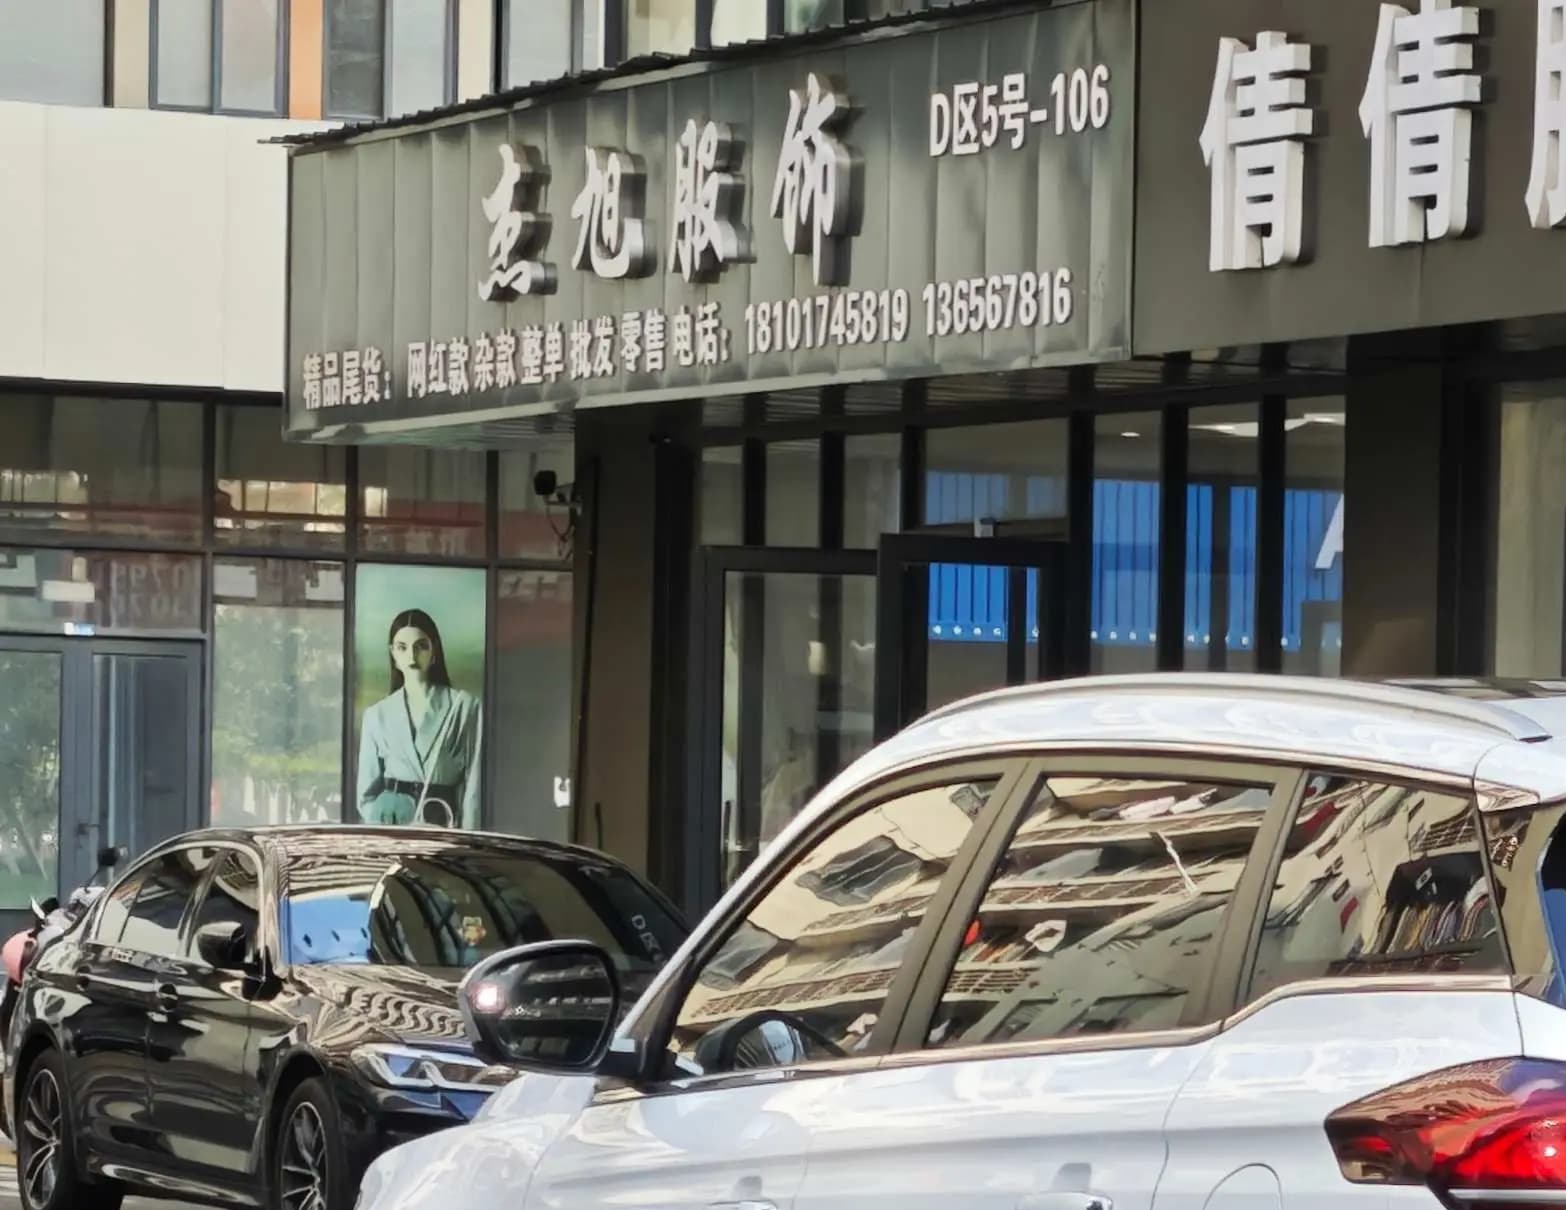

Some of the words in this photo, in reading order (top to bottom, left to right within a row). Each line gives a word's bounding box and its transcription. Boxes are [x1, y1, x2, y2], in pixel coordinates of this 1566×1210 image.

[930, 64, 1111, 157] D区5号-106
[744, 288, 910, 354] 18101745819
[922, 267, 1073, 336] 136567816
